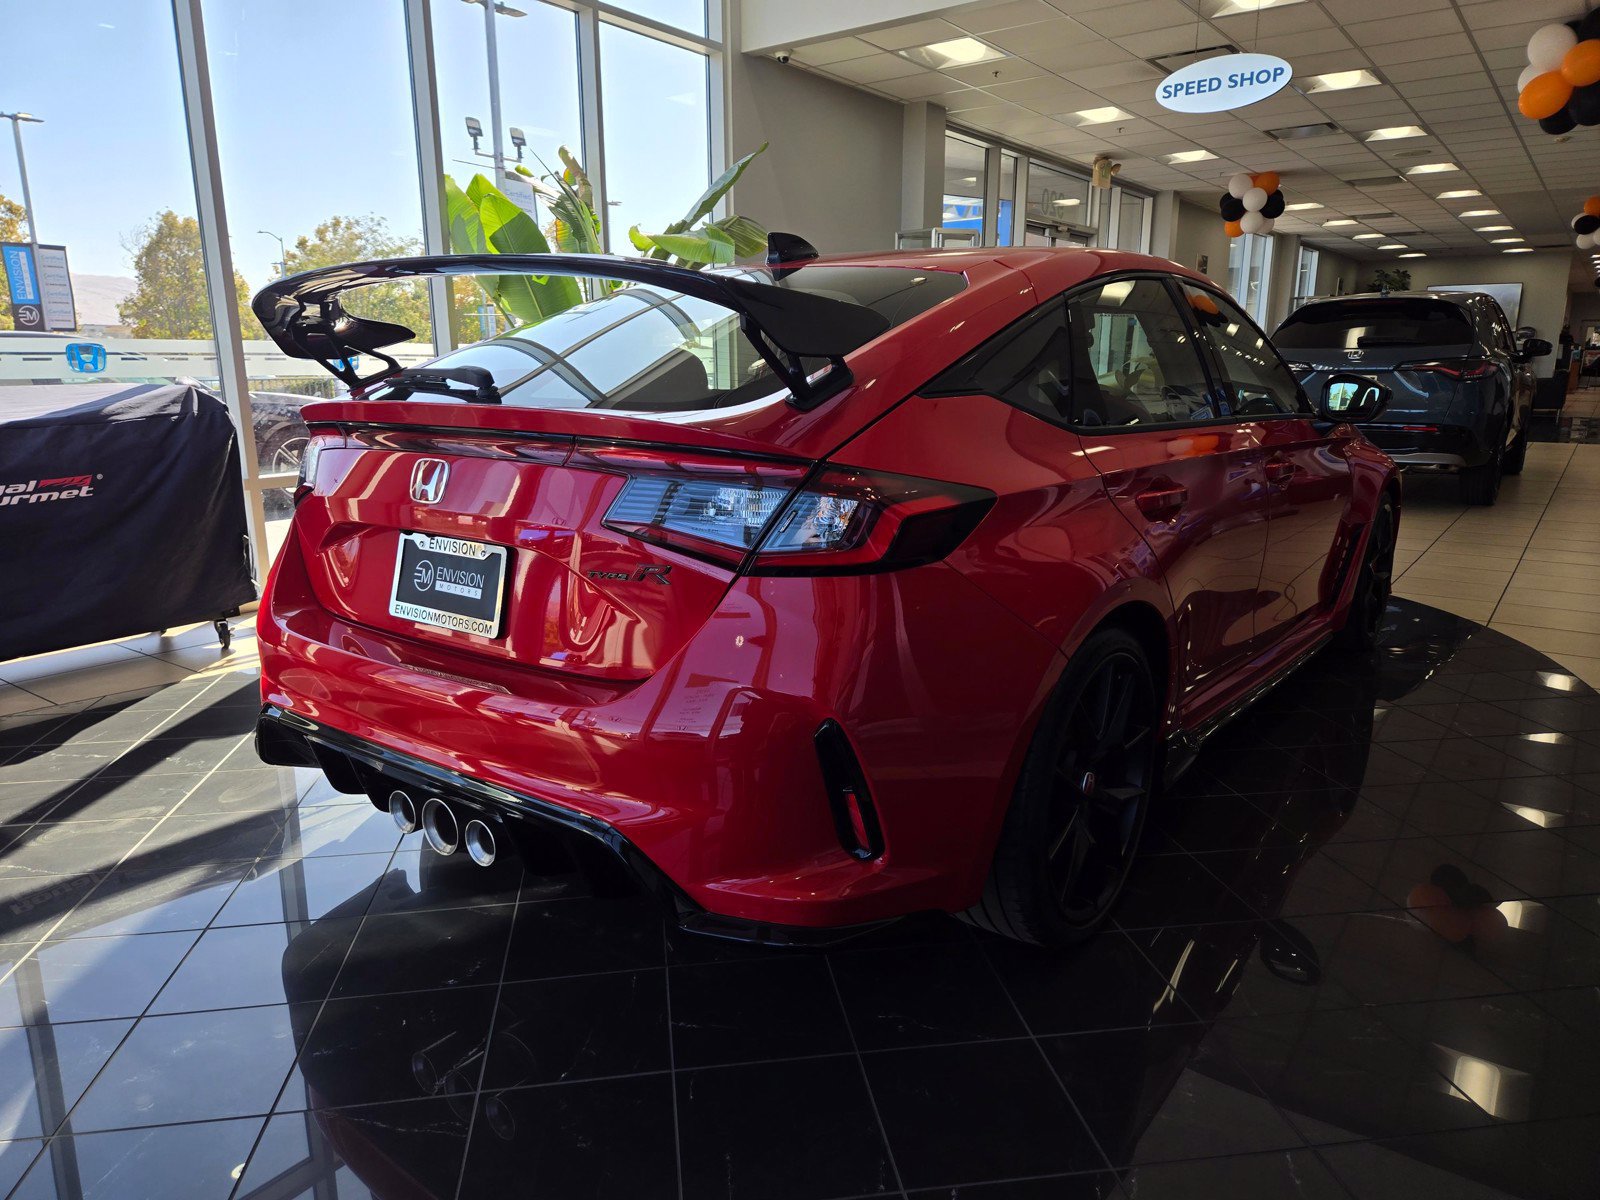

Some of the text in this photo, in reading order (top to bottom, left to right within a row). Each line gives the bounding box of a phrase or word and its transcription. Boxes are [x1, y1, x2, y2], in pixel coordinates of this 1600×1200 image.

[1162, 67, 1285, 99] SPEED SHOP
[9, 250, 27, 300] ENVISION
[429, 537, 477, 557] ENVISION
[436, 566, 485, 588] ENVISION
[438, 583, 479, 597] MOTORS
[394, 604, 493, 636] ENVISIONMOTORS.COM
